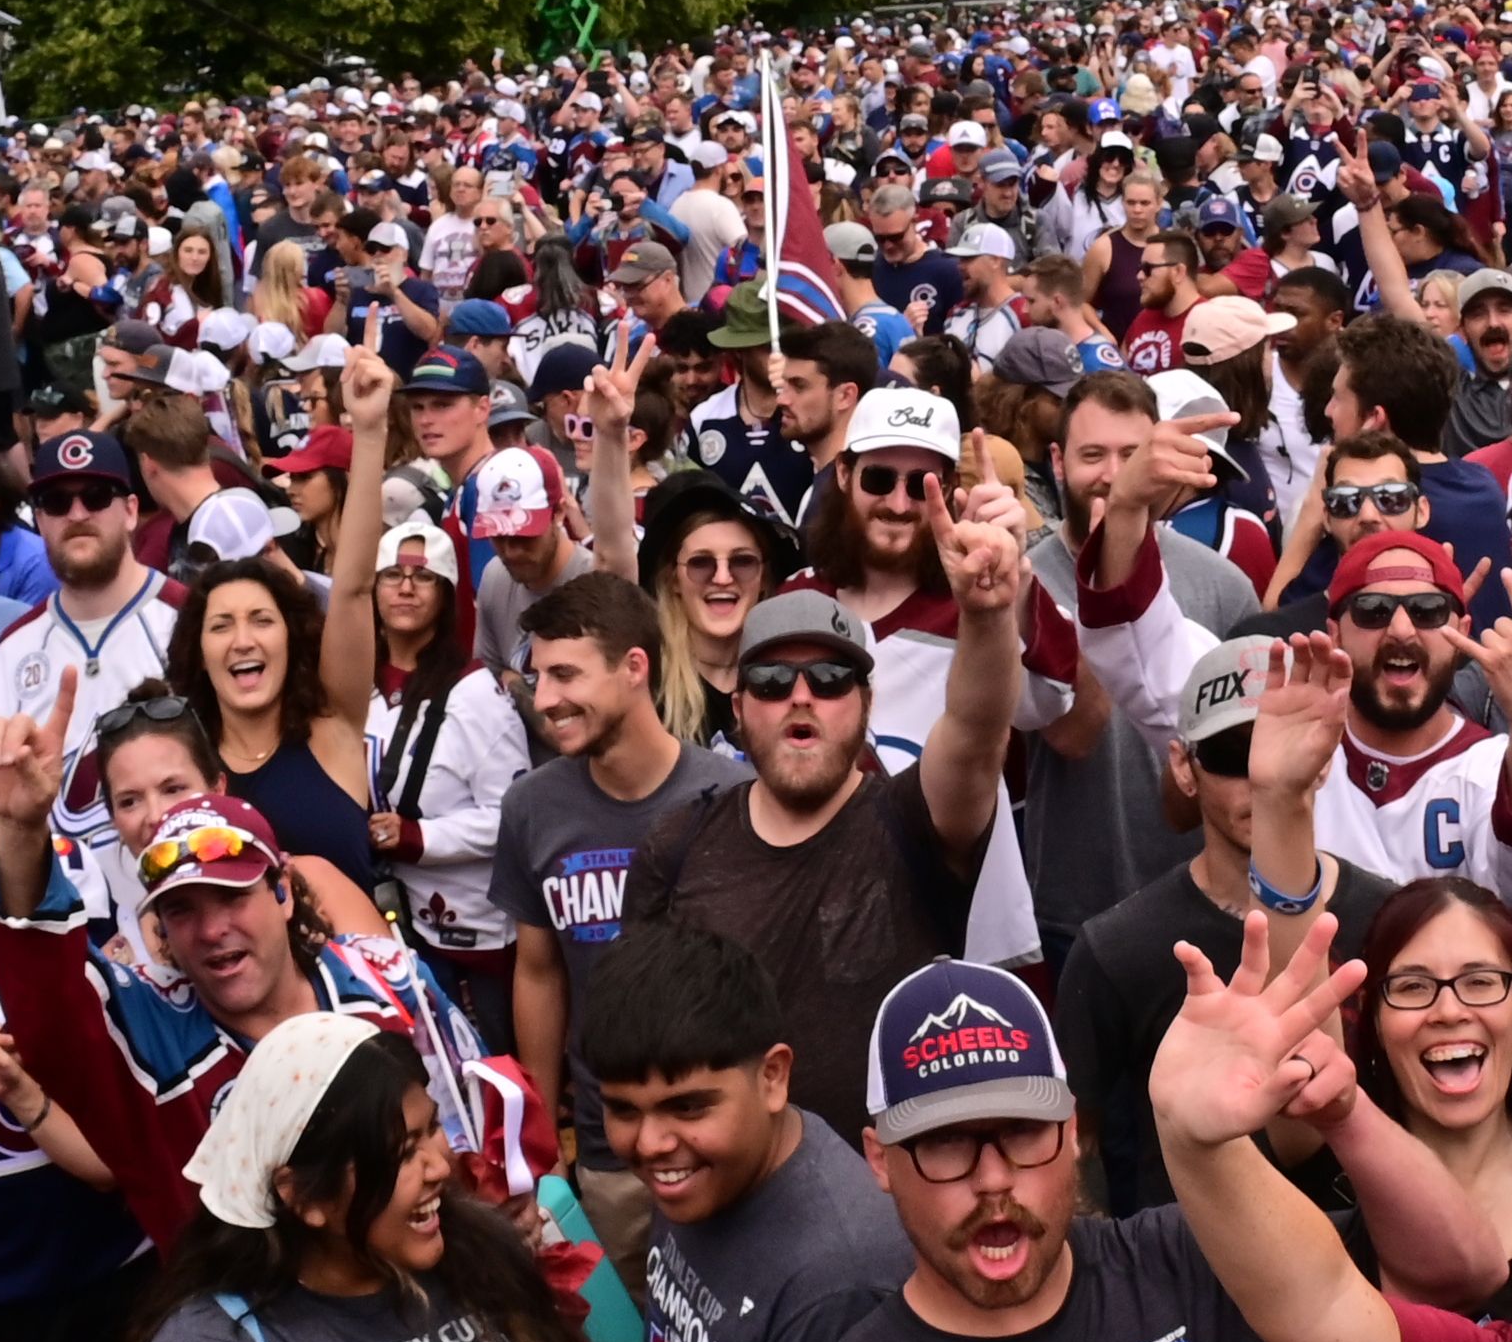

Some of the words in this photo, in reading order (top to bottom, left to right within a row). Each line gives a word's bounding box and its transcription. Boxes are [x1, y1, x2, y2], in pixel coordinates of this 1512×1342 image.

[887, 406, 933, 428] Bad
[1195, 668, 1252, 715] FOX
[1423, 796, 1467, 870] C
[902, 1025, 1032, 1070] SCHEELS
[917, 1048, 1021, 1079] COLORADO
